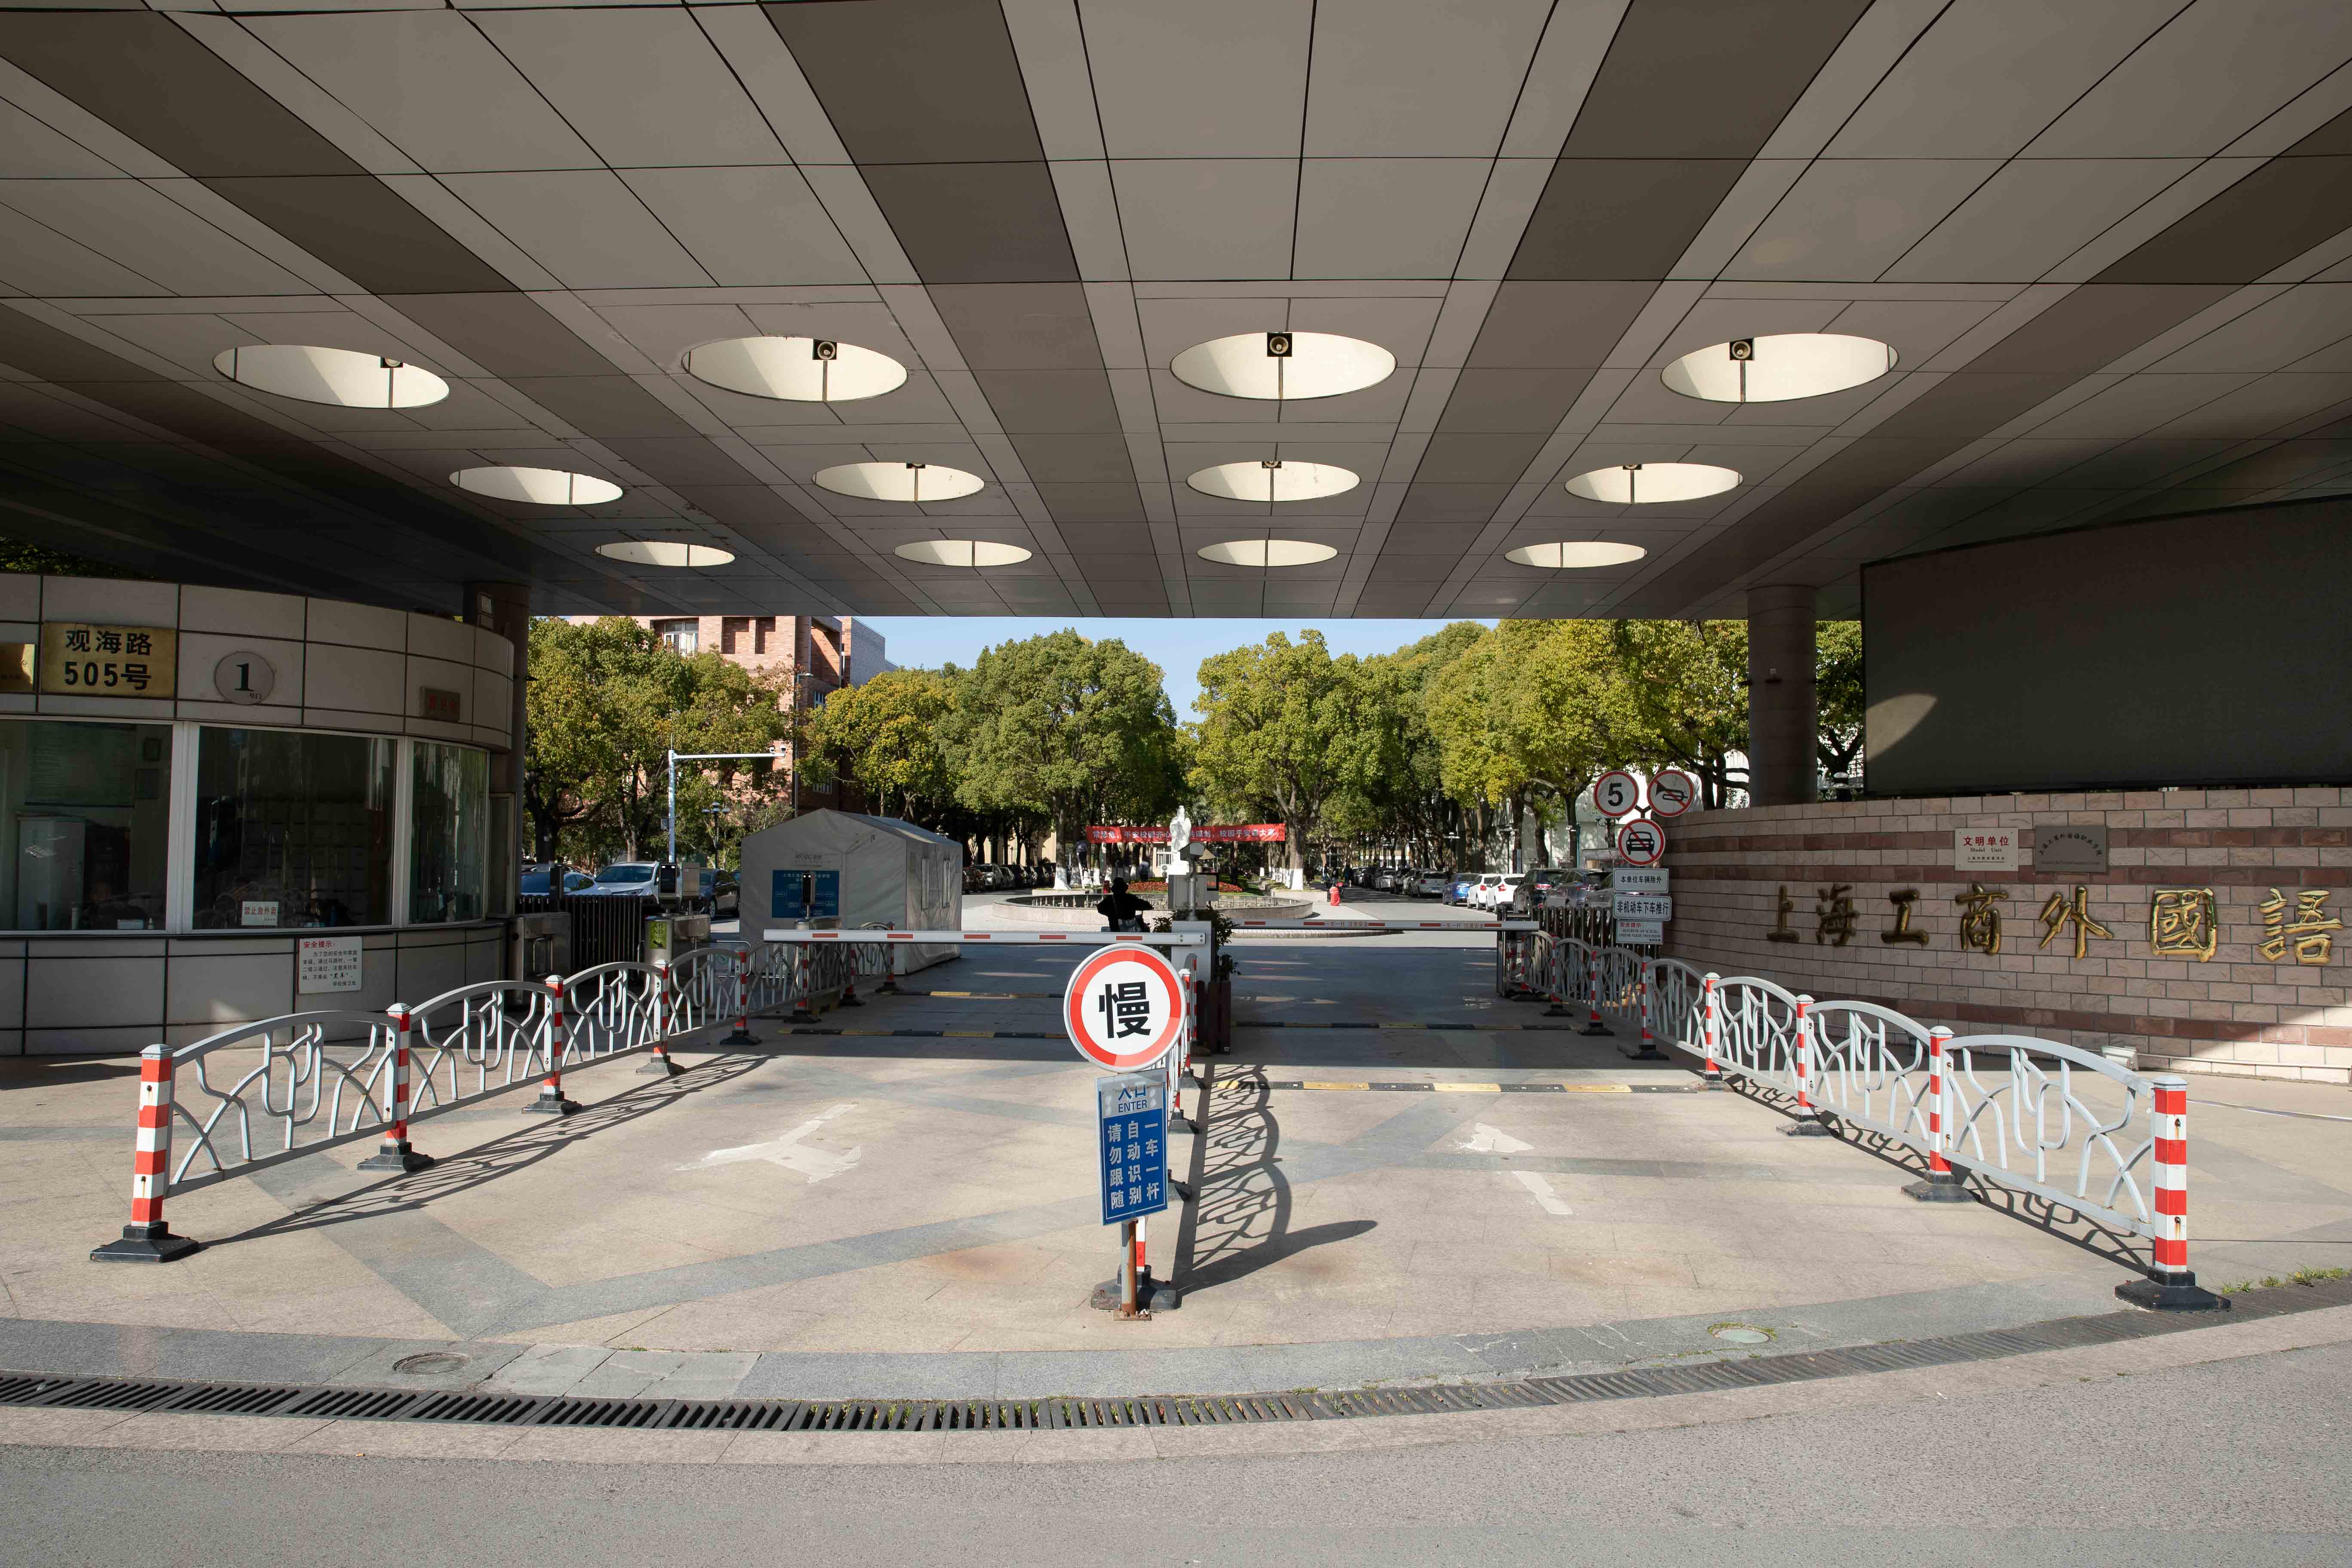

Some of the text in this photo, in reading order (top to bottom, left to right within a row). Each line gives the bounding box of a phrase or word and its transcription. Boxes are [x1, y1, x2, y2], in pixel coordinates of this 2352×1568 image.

[65, 629, 153, 656] 观海路
[64, 661, 152, 690] 505号
[235, 663, 254, 692] 1
[1608, 782, 1623, 807] 5
[1963, 836, 2009, 846] 文明单位
[1620, 875, 1662, 884] 本单位车辆除外
[1617, 900, 1669, 915] 非机动车下车推行
[1099, 982, 1151, 1038] 慢
[1118, 1099, 1148, 1113] ENTER
[1107, 1123, 1125, 1210] 请勿跟随
[1127, 1121, 1142, 1205] 自动识别
[1145, 1122, 1160, 1201] 一车一杆
